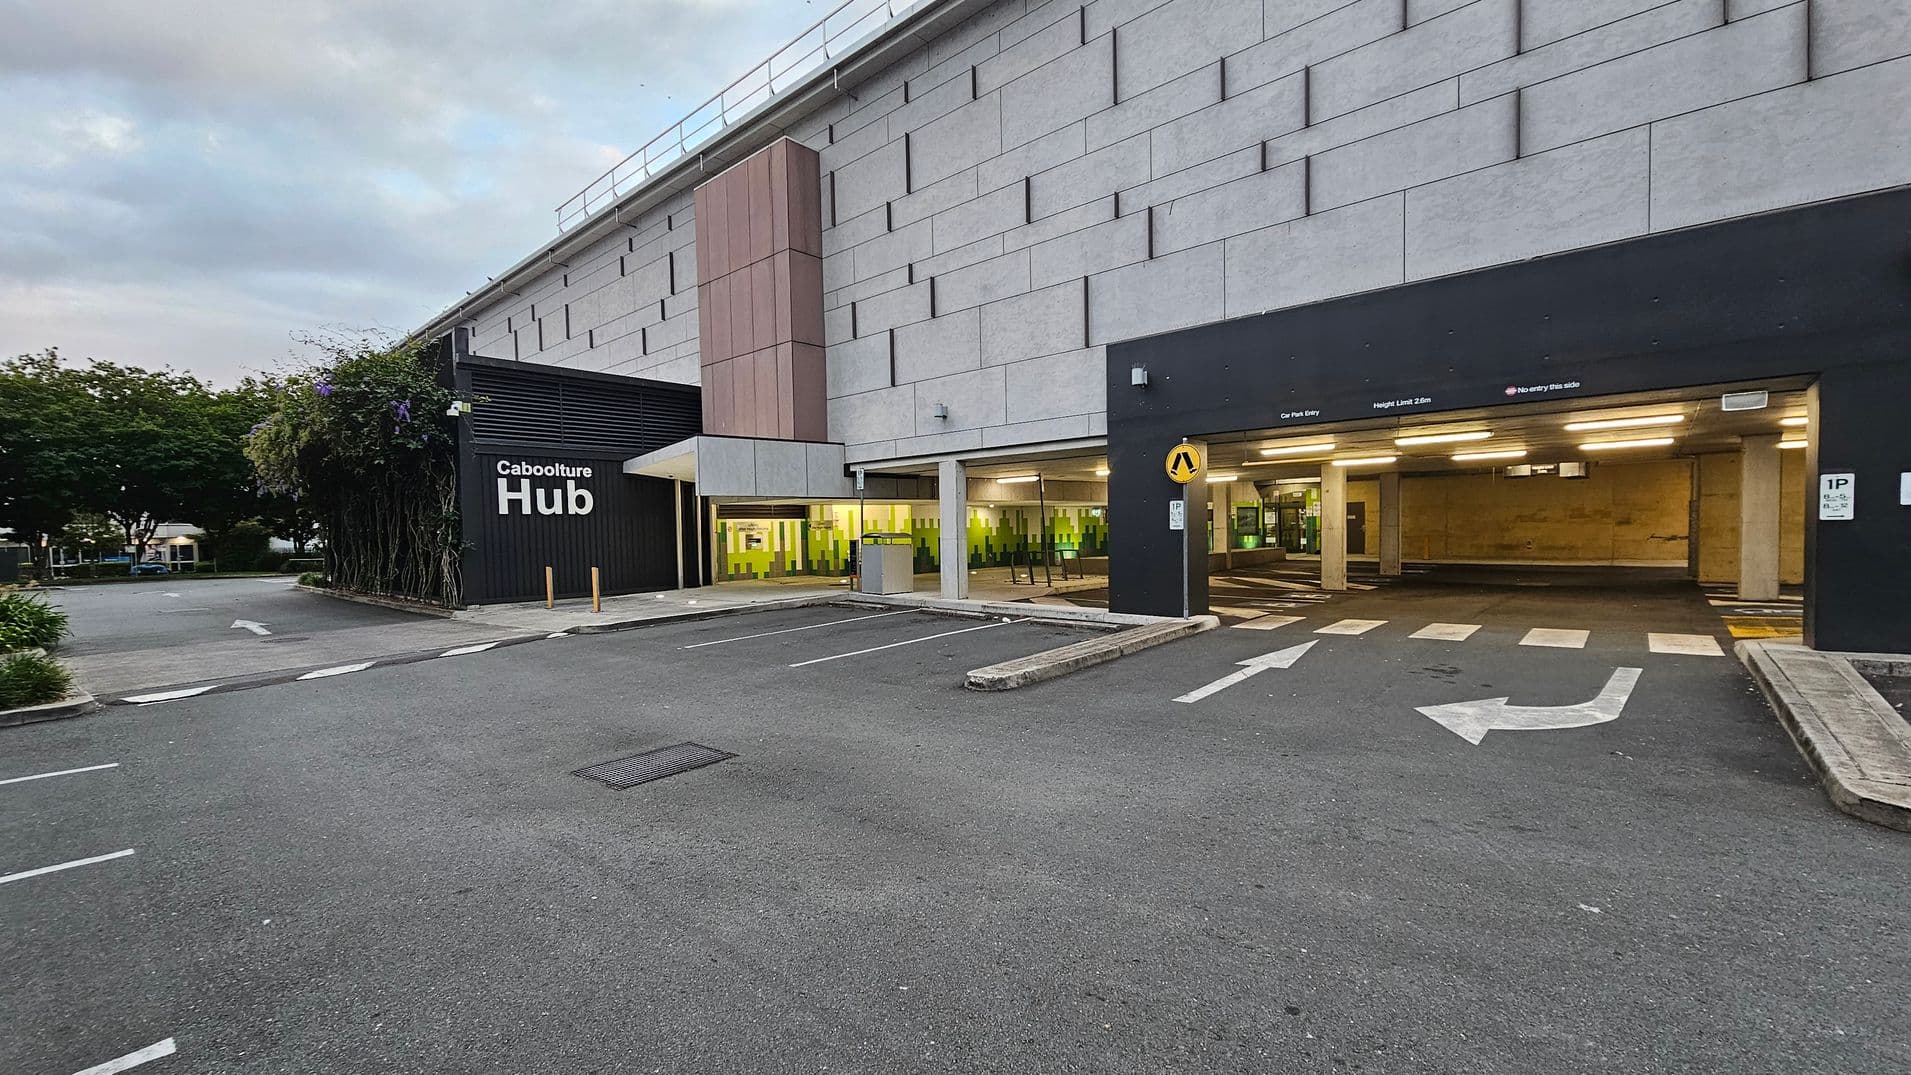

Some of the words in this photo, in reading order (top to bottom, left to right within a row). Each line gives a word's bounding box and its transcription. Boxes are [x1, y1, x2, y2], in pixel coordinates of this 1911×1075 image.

[1529, 385, 1549, 393] entry
[1549, 383, 1563, 391] this
[1563, 381, 1580, 389] side
[1373, 401, 1395, 409] Height
[1396, 399, 1413, 407] Limit
[496, 460, 593, 478] Caboolture
[1827, 478, 1849, 490] 1P
[497, 477, 594, 515] Hub
